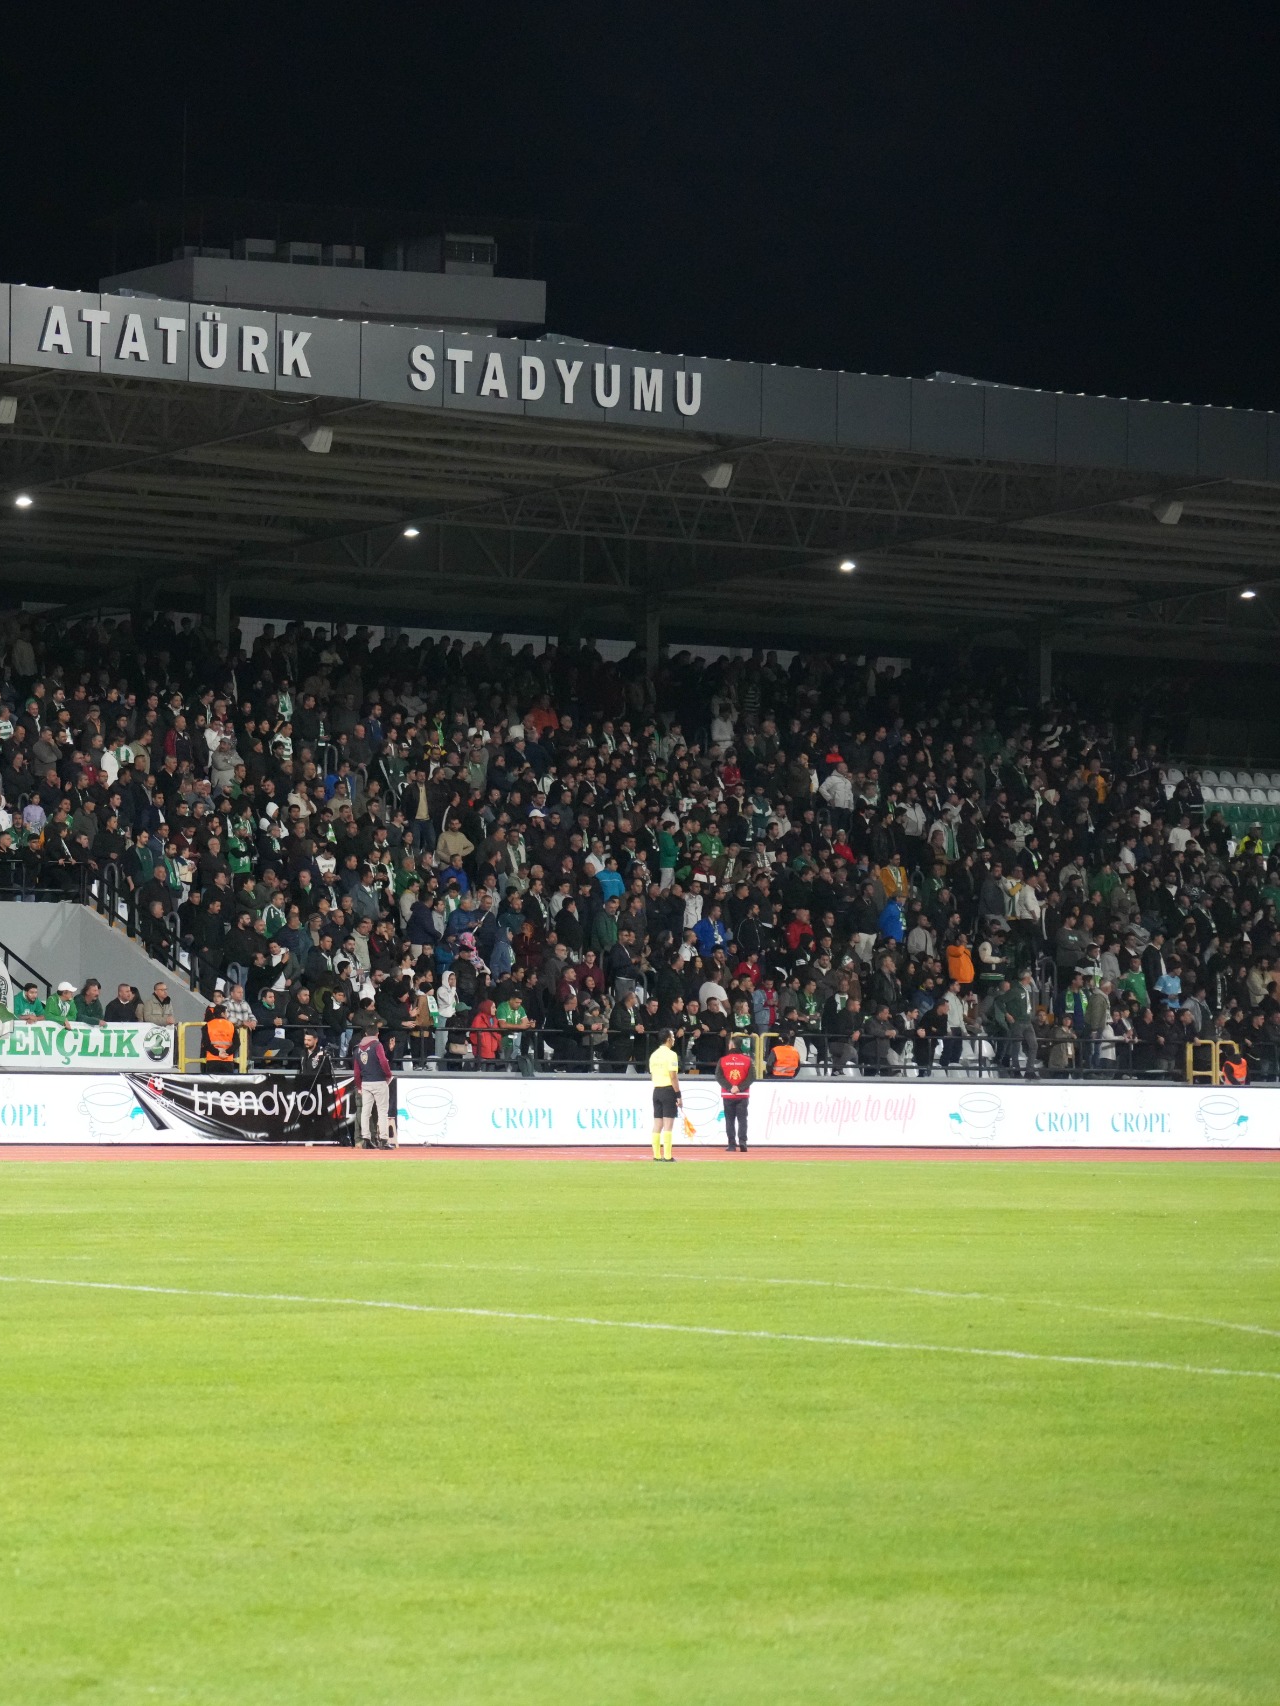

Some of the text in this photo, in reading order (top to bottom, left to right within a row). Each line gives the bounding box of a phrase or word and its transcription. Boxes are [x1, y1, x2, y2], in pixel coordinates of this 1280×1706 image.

[38, 305, 312, 378] ATATÜRK
[409, 345, 702, 416] STADYUMU
[191, 1083, 322, 1123] trendyol
[576, 1107, 644, 1130] CROPE
[765, 1088, 917, 1140] from crope to cup
[1111, 1112, 1171, 1133] CROPE
